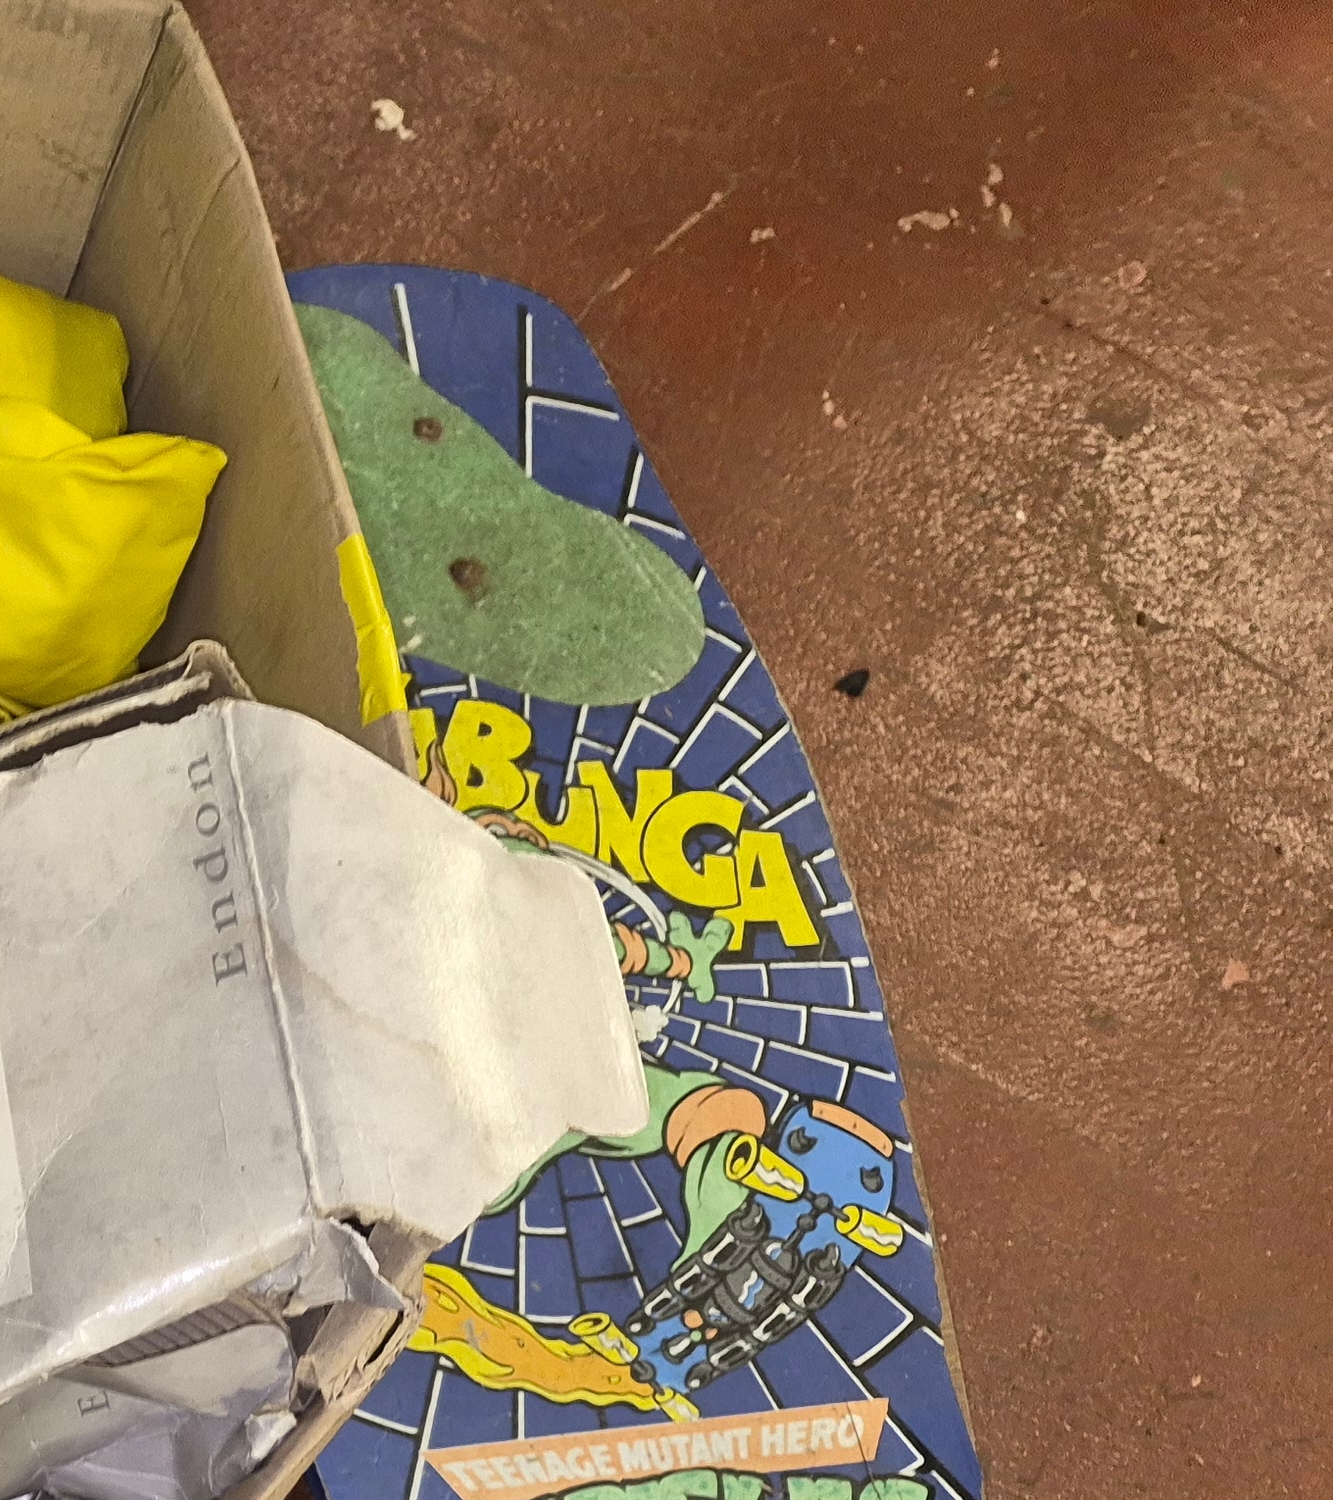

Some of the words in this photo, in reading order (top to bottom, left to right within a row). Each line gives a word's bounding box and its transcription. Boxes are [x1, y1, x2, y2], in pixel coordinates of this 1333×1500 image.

[187, 752, 248, 987] Endon
[441, 1441, 615, 1493] TEENAGE
[617, 1427, 754, 1473] MUTANT
[759, 1414, 866, 1458] HERO
